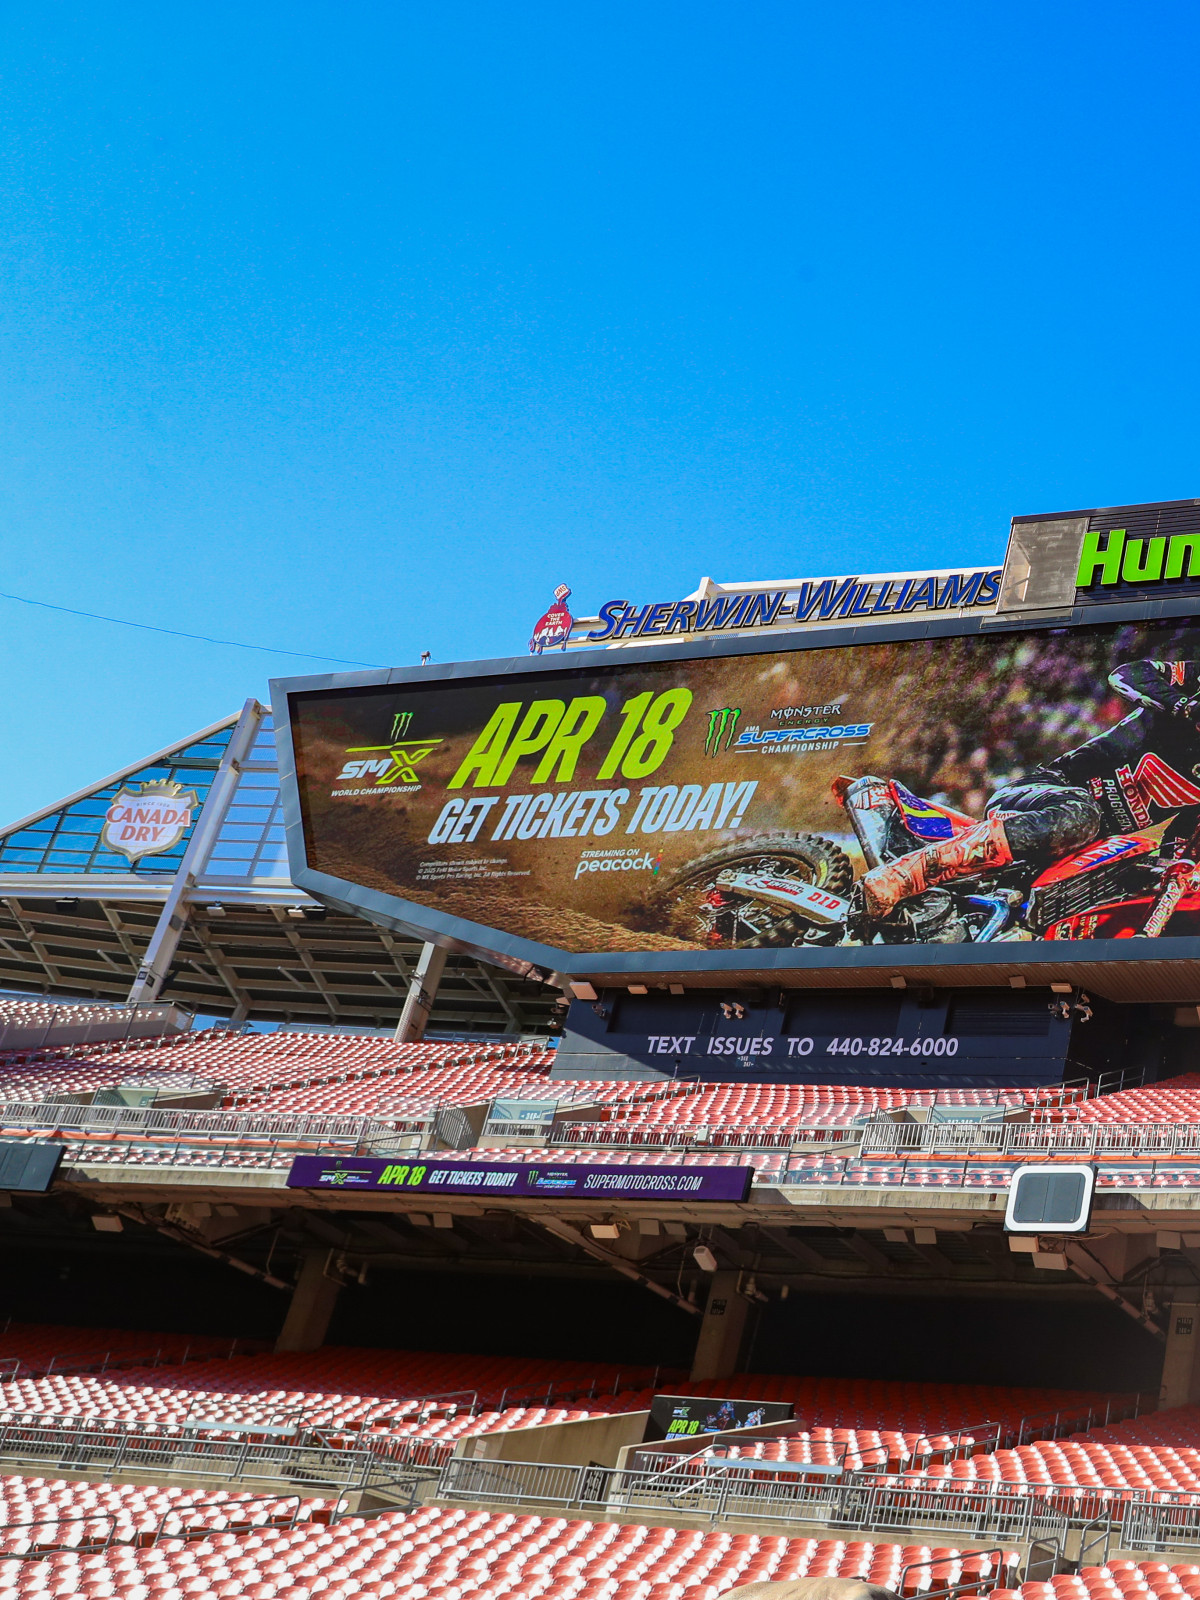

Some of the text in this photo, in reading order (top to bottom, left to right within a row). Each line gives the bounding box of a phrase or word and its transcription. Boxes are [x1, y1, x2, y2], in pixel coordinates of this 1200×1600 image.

[586, 570, 1003, 642] SHERWIN-WILLIAMS
[779, 718, 829, 726] ENERGY
[447, 687, 693, 789] APR 18
[734, 723, 874, 746] SUPERCROSS
[761, 742, 839, 754] CHAMPIONSHIP
[336, 748, 434, 784] SMX
[331, 785, 422, 797] WORLD CHAMPIONSHIP
[106, 805, 190, 826] CANADA
[427, 781, 759, 844] GET TICKETS TODAY!
[120, 825, 165, 841] DRY
[580, 848, 640, 858] STREAMING ON
[574, 852, 654, 880] peacock
[646, 1036, 959, 1057] TEXT ISSUES TO 440-824-6000
[319, 1173, 348, 1184] SMX
[376, 1165, 410, 1185] APR
[406, 1166, 426, 1186] 18
[428, 1170, 449, 1184] GET
[446, 1171, 485, 1185] TICKETS
[483, 1172, 518, 1187] TODAY!
[583, 1173, 704, 1192] SUPERMOTOCROSS.COM
[668, 1419, 688, 1434] APR
[687, 1420, 699, 1434] 18
